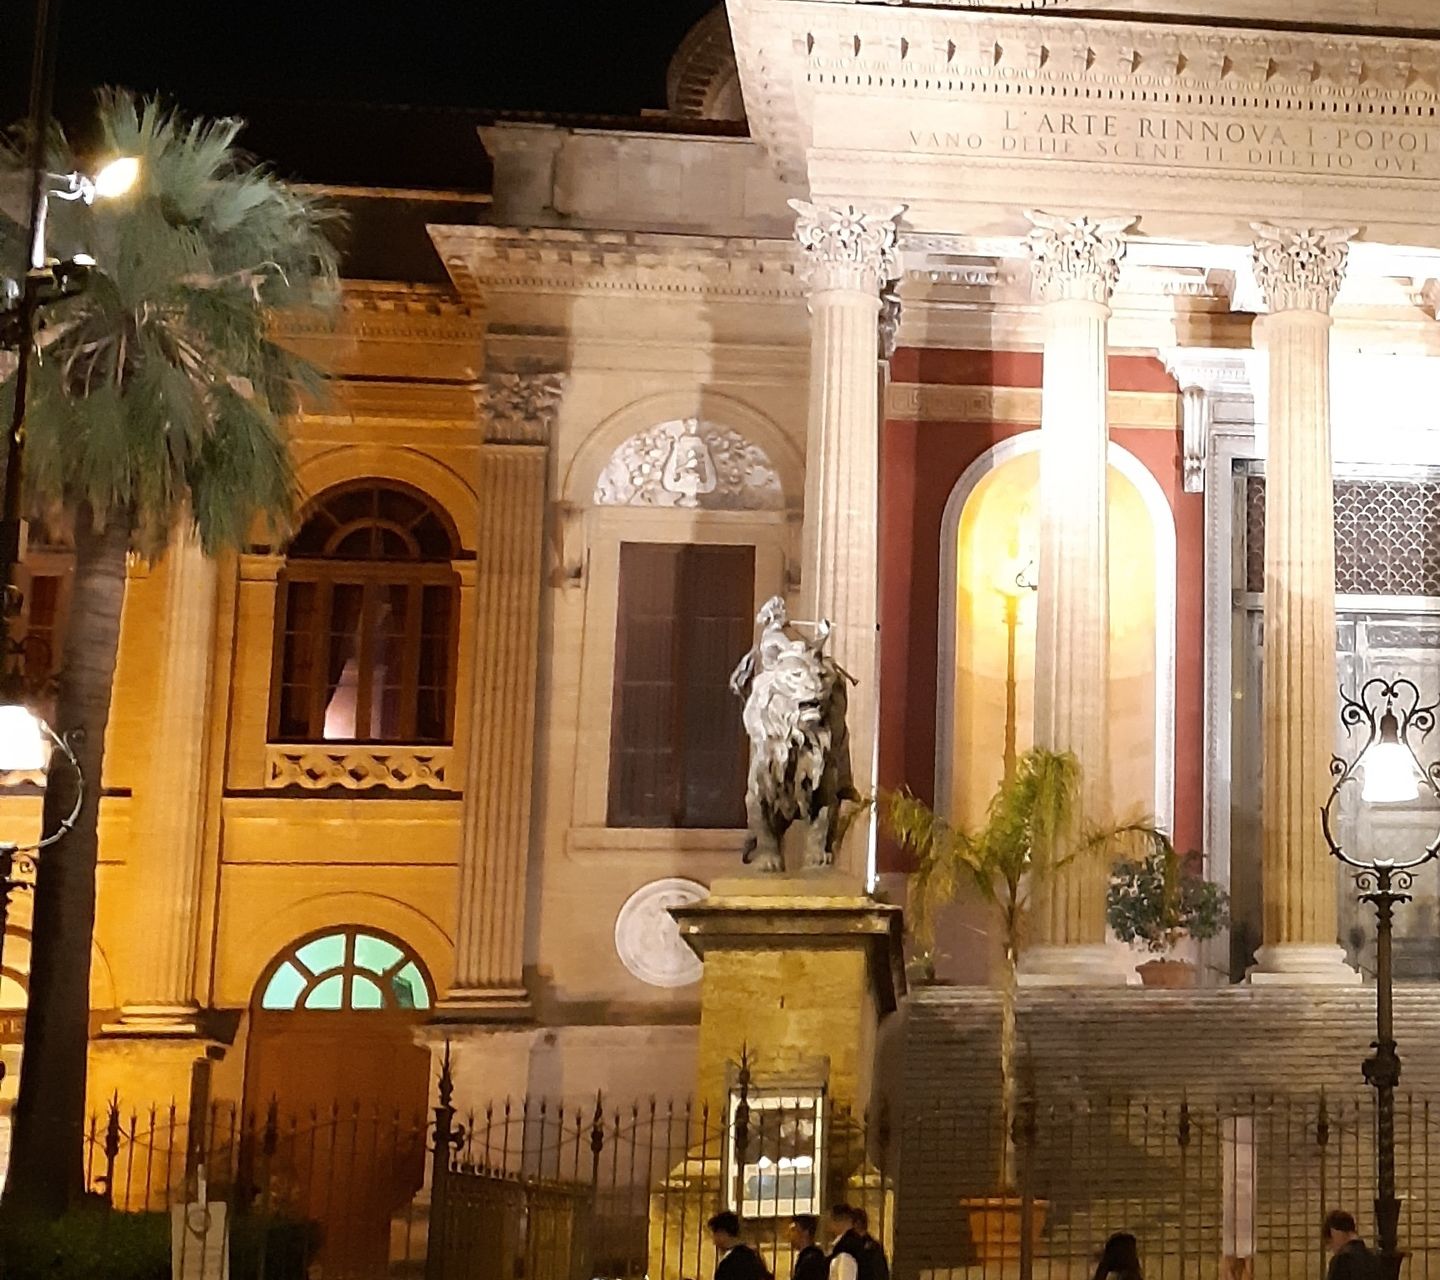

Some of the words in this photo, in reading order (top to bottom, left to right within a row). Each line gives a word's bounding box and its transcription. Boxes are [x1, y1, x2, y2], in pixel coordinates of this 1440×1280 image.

[1005, 110, 1118, 137] L'ARTE
[1139, 118, 1287, 147] RINNOVA
[1307, 125, 1315, 147] I
[909, 130, 983, 150] VANO
[1001, 135, 1075, 156] DELLE
[1097, 140, 1187, 160] SCENE
[1205, 145, 1230, 162] IL
[1248, 148, 1353, 169] DILETTO
[1374, 155, 1420, 172] OVE
